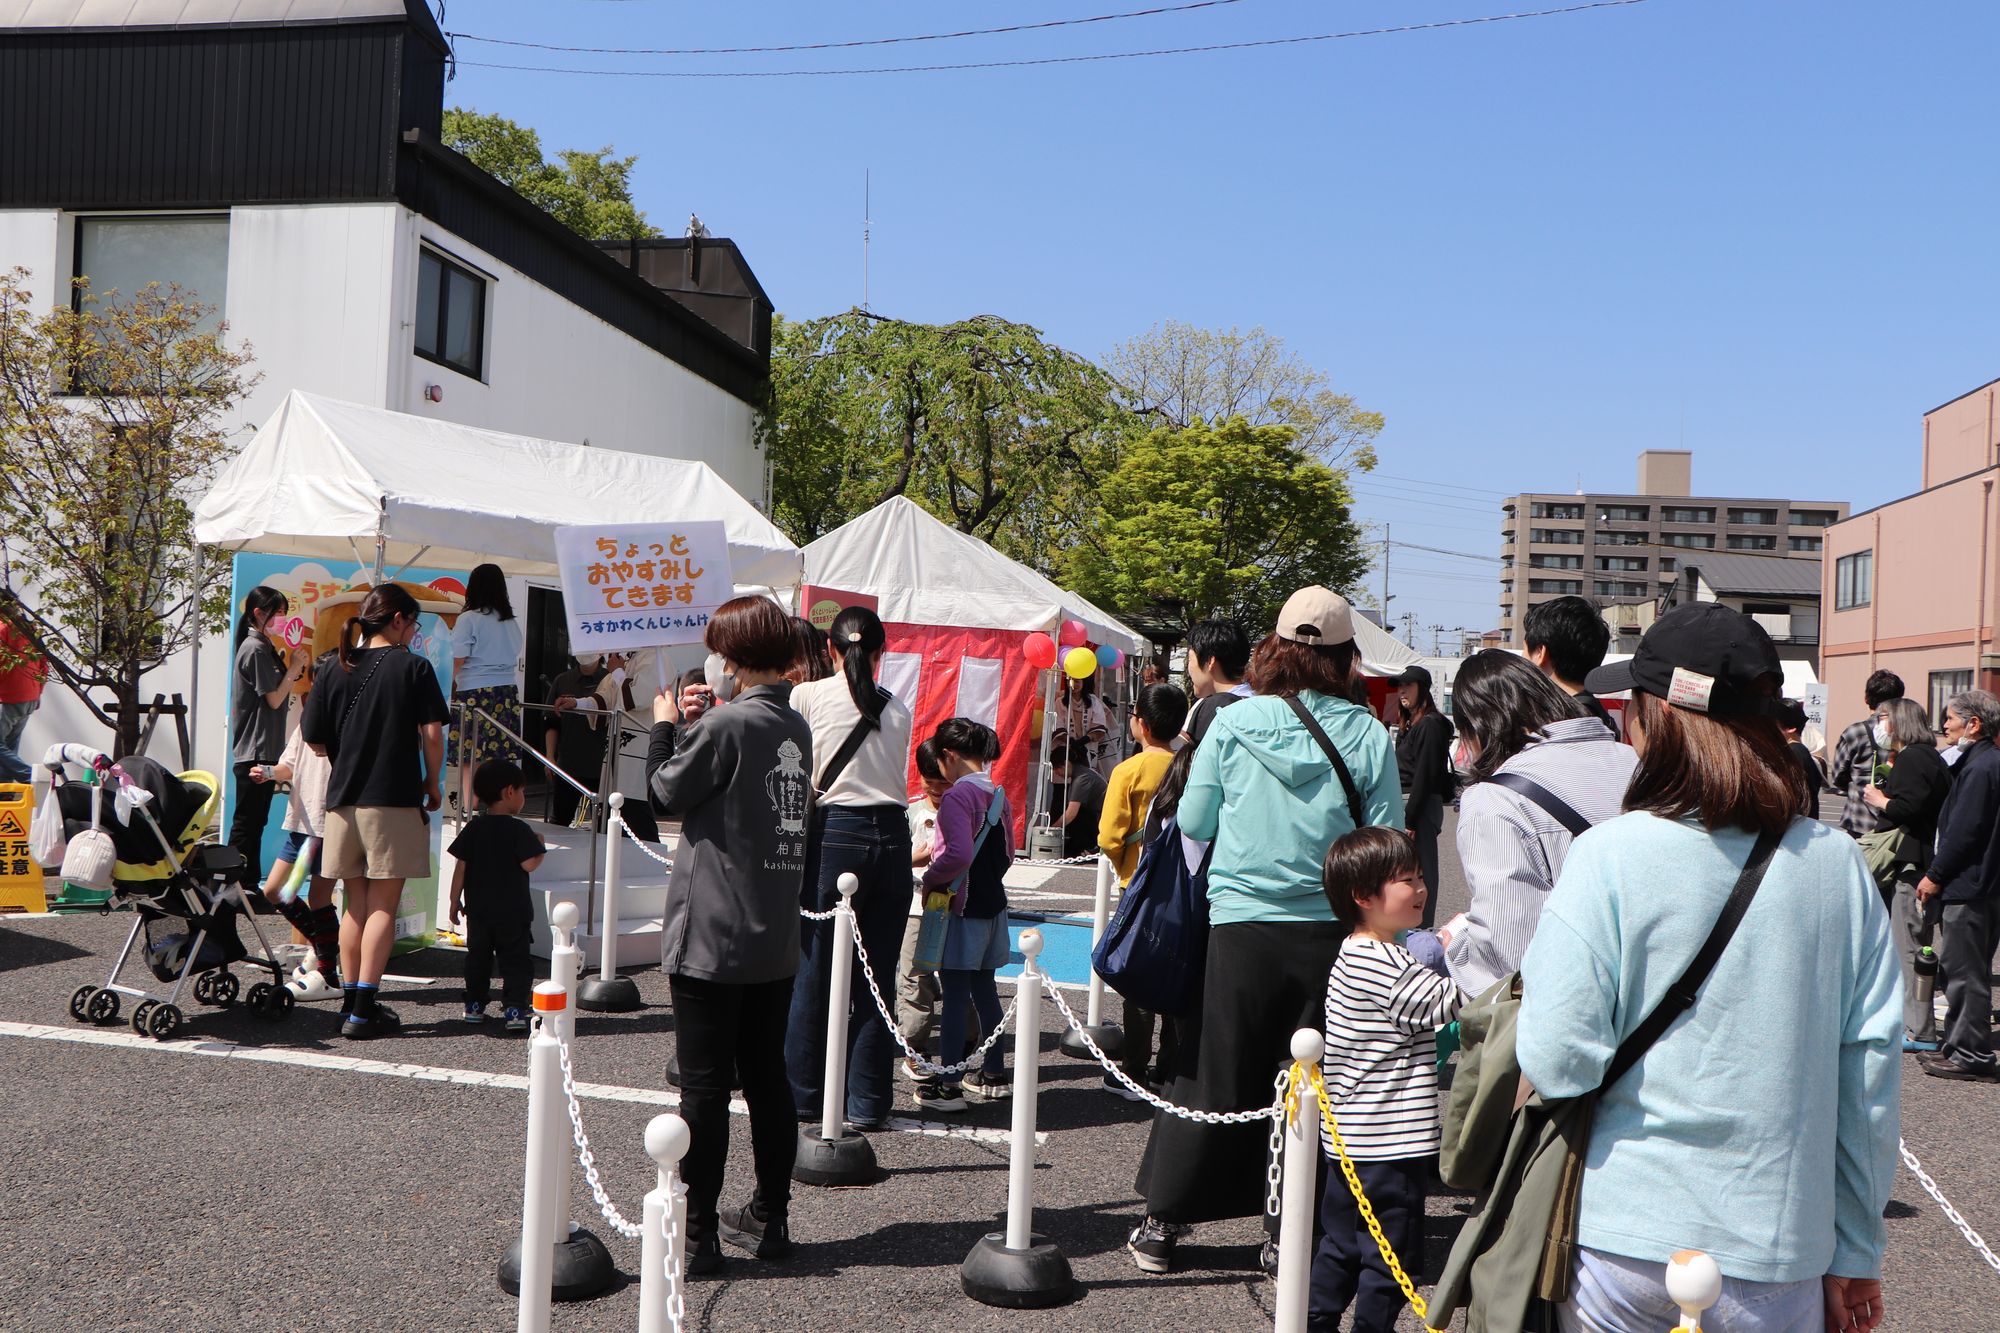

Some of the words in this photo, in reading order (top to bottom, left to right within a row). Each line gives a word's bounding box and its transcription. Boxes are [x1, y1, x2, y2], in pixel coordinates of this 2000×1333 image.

[596, 534, 689, 559] ちょっと
[587, 558, 704, 585] おやすみし
[602, 582, 695, 609] てきます
[776, 841, 803, 857] 柏屋
